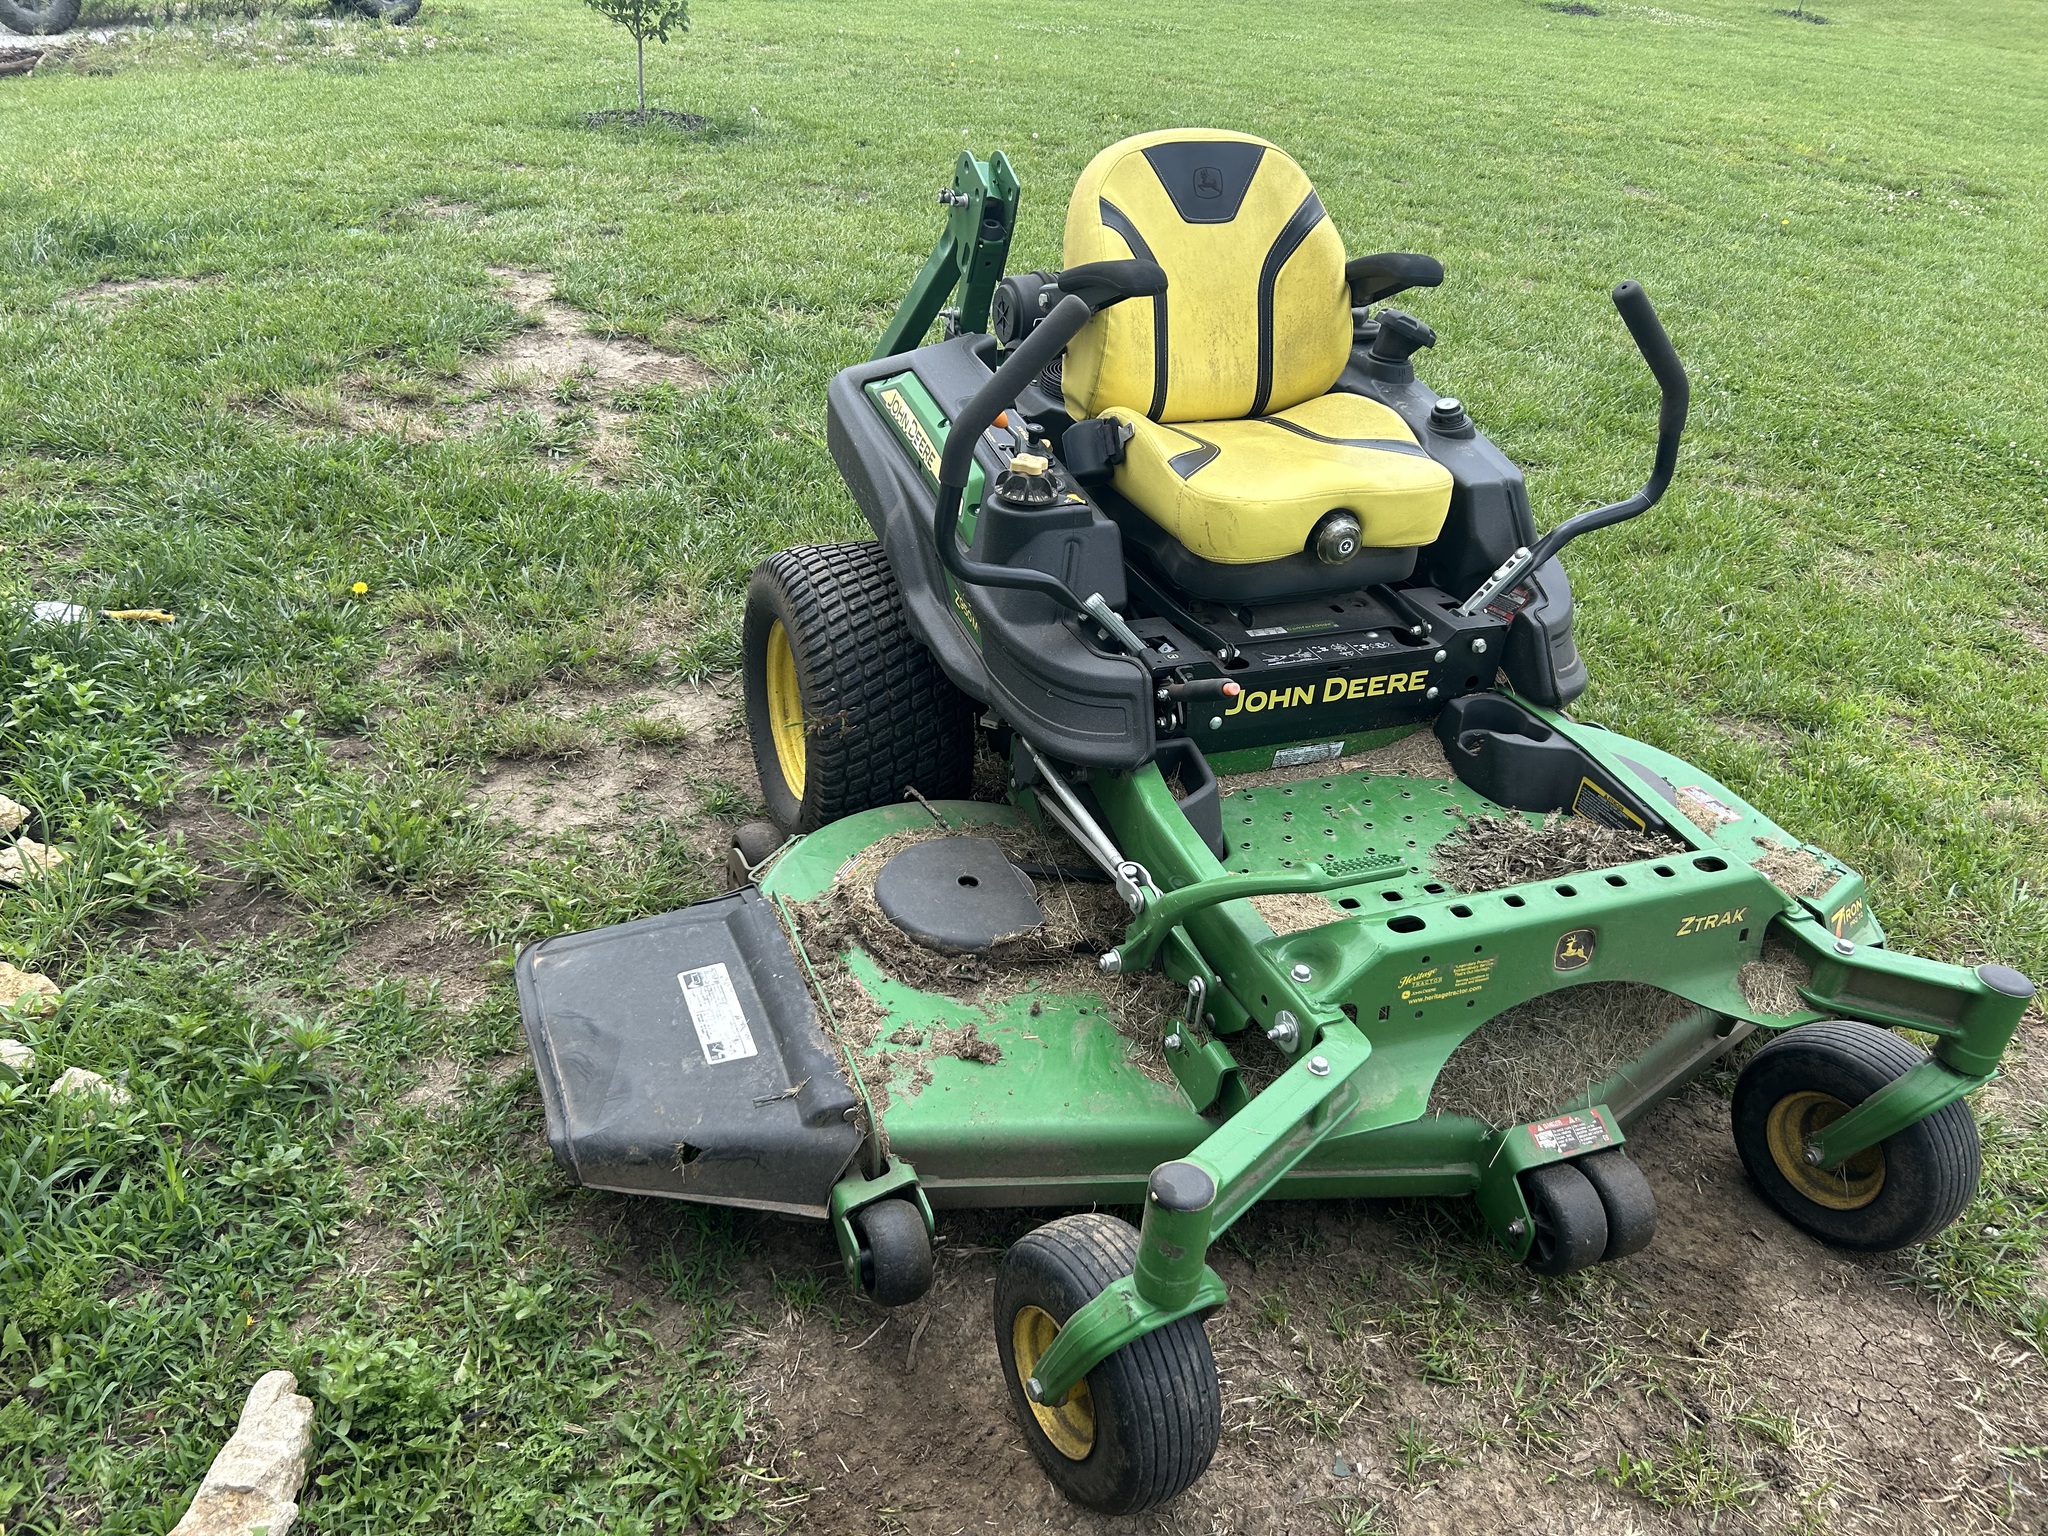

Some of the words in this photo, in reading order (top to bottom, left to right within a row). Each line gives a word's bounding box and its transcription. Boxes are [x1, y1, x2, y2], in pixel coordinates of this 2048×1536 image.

[887, 392, 910, 430] JOHN
[908, 419, 936, 469] DEERE
[1224, 684, 1316, 716] JOHN
[1322, 669, 1430, 703] DEERE
[1675, 906, 1750, 938] ZTRAK
[1397, 967, 1438, 989] Heritage
[1411, 976, 1443, 988] TRACTOR
[1408, 985, 1482, 1005] www.heritagetractor.com
